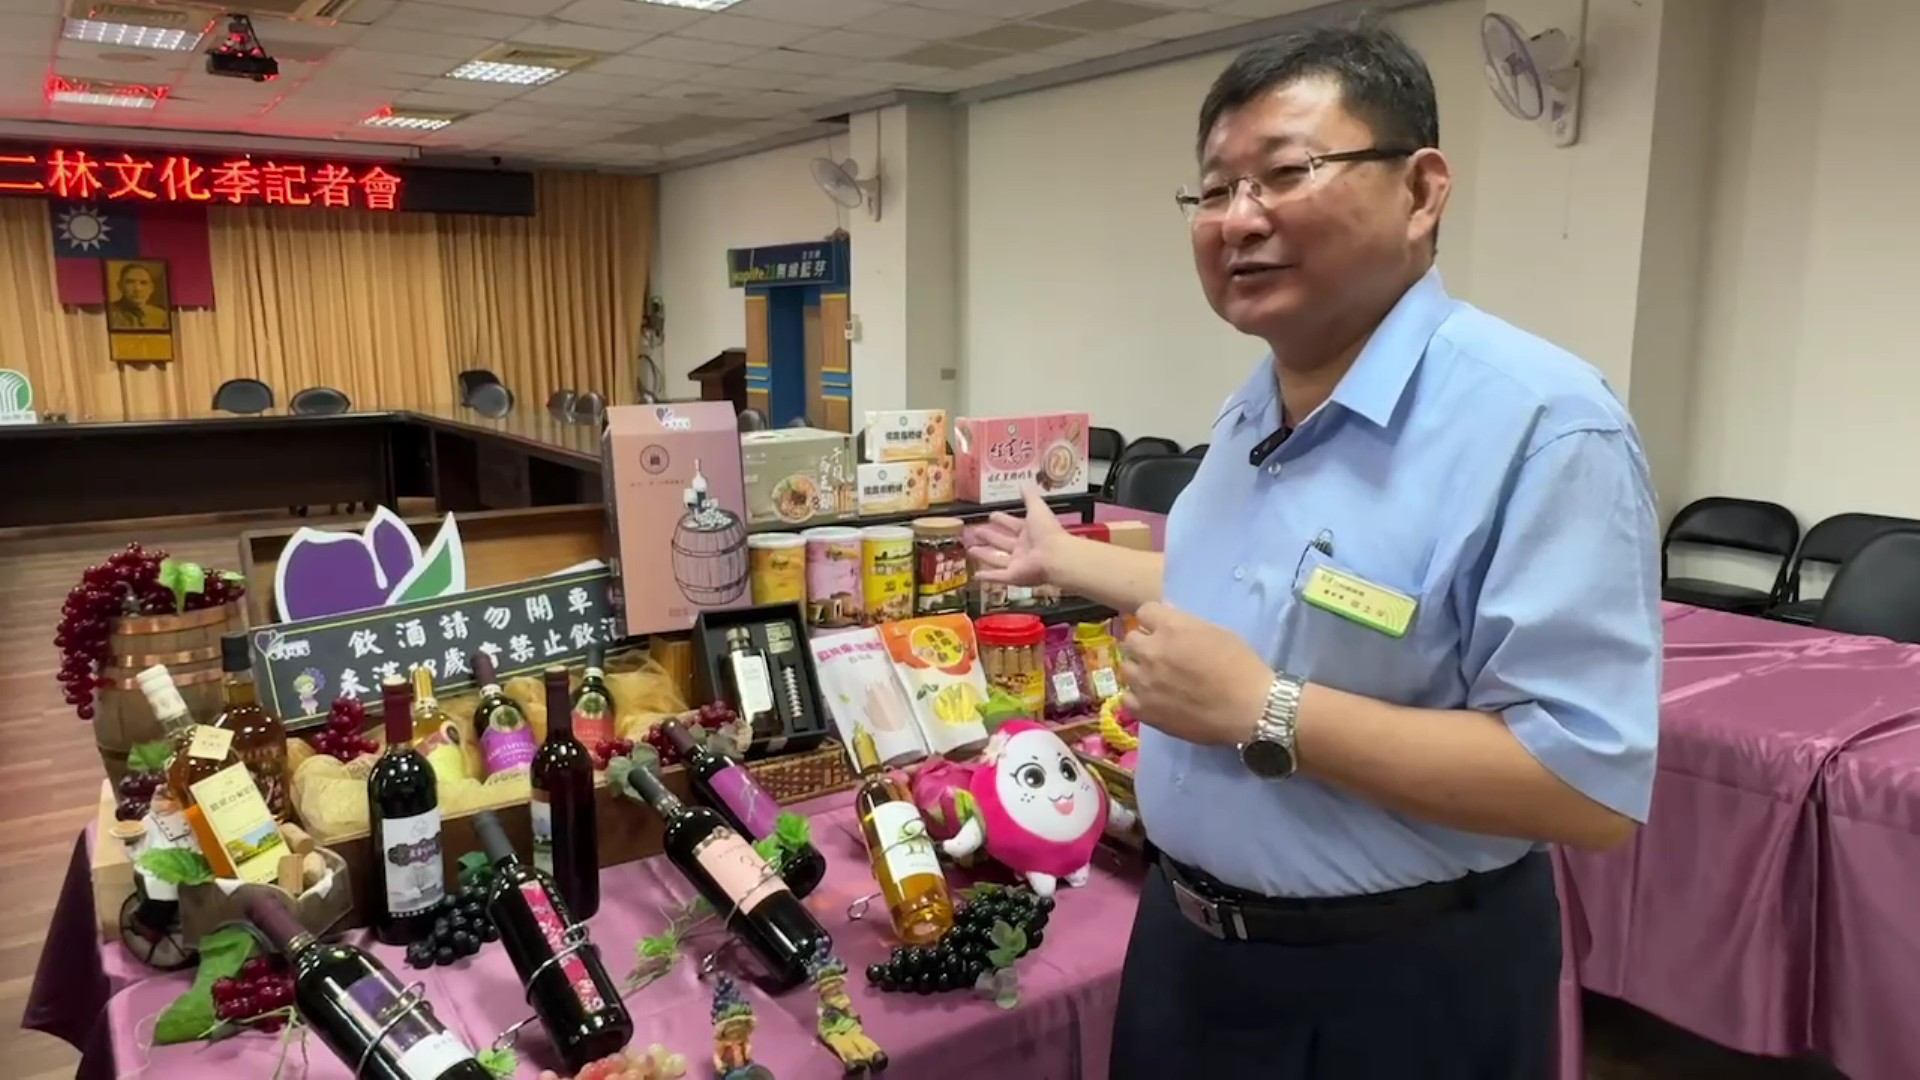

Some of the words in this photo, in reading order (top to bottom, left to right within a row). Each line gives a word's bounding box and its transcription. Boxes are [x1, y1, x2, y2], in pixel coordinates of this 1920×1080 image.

[0, 149, 402, 211] 二林文化季記者會
[348, 586, 594, 659] 飲酒請勿開車
